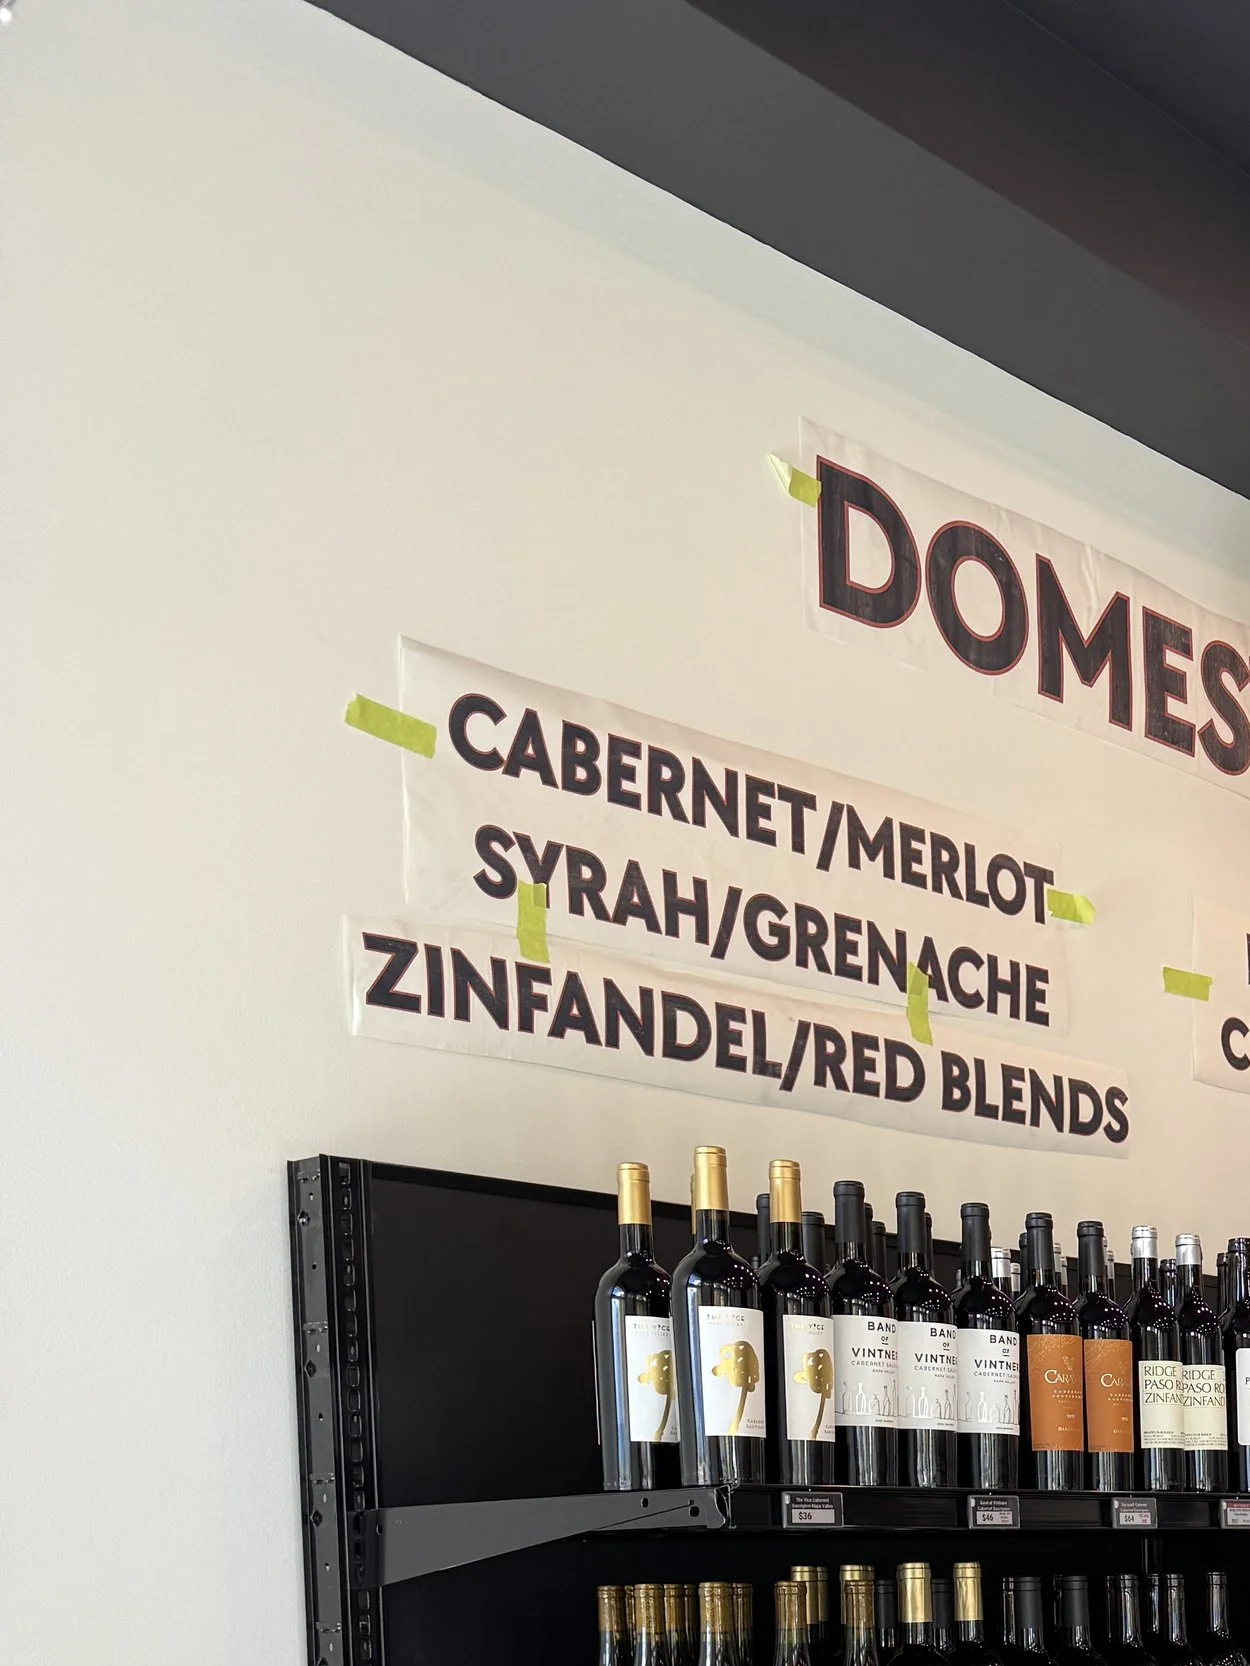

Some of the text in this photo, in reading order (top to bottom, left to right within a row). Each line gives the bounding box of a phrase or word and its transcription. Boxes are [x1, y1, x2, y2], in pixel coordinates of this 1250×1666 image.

[449, 693, 1054, 926] CABERNET/MERLOT
[474, 824, 1050, 1027] SYRAH/GRENACHE
[363, 932, 1130, 1143] ZINFANDEL/RED BLENDS
[868, 1321, 897, 1334] BAND
[930, 1327, 956, 1340] BAND
[989, 1334, 1018, 1346] BAND
[1144, 1365, 1177, 1377] RIDGE
[1182, 1369, 1216, 1380] RIDGE
[1145, 1379, 1173, 1390] PASO
[1183, 1382, 1212, 1393] PASO
[798, 1512, 812, 1520] $36
[982, 1513, 993, 1521] $46
